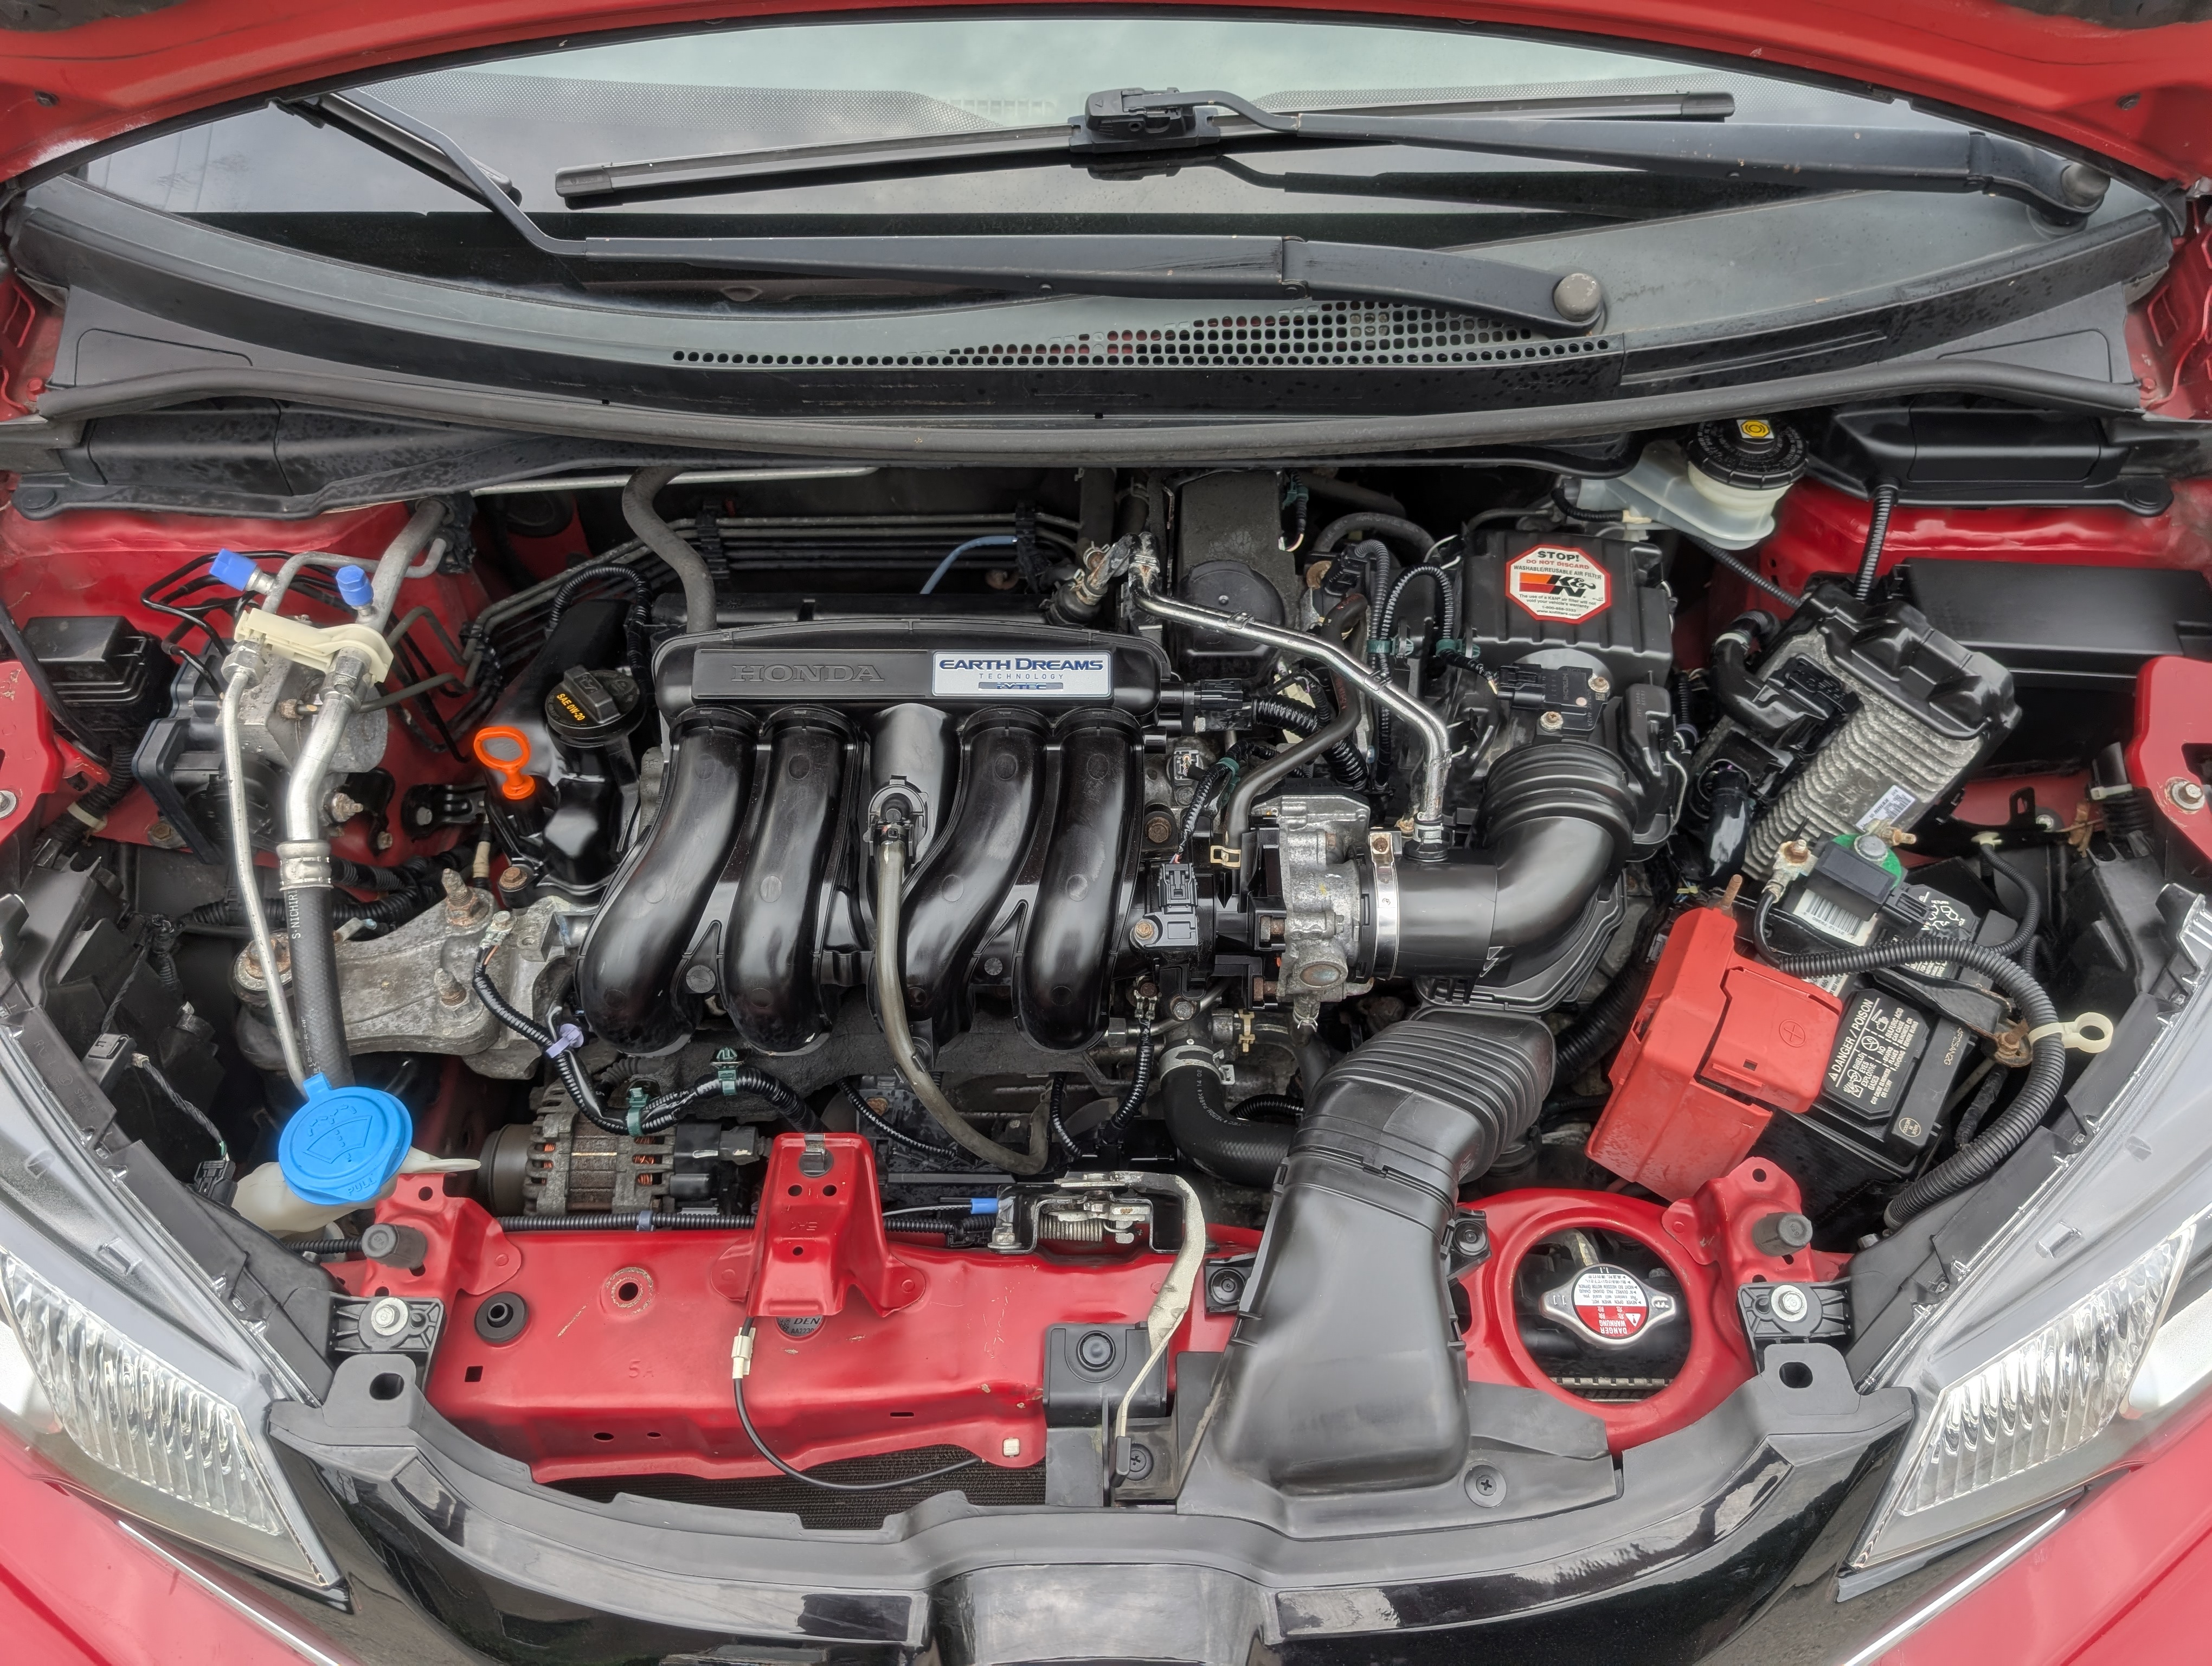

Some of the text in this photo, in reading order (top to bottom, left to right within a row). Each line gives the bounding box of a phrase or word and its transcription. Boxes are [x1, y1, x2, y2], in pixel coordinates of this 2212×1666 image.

[1538, 551, 1579, 562] STOP!
[1514, 565, 1572, 575] WASHABLE/REUSABLE
[939, 658, 1103, 671] EARTH DREAMS
[731, 664, 885, 683] HONDA
[997, 682, 1047, 690] i-VTEC
[557, 693, 586, 721] SAE 0W-20
[1885, 1007, 1904, 1038] SULFURIC ACID
[1895, 1020, 1905, 1033] CAUSE
[1835, 1035, 1855, 1073] DANGER
[1853, 998, 1874, 1031] POISON
[1897, 1024, 1910, 1045] BLINDNESS
[1903, 1021, 1919, 1047] SEVERE BURNS
[1877, 1046, 1886, 1055] NO
[1853, 1053, 1864, 1070] SHIELD
[1859, 1061, 1869, 1074] EYES
[1861, 1062, 1876, 1087] EXPLOSIVE
[1868, 1075, 1880, 1091] GASES
[1870, 1068, 1891, 1105] CAN CAUSE BLINDNESS
[1902, 1119, 1912, 1133] MEXICO
[1911, 1124, 1919, 1136] MADE
[347, 1177, 377, 1196] PULL
[1553, 1295, 1567, 1306] 1.1
